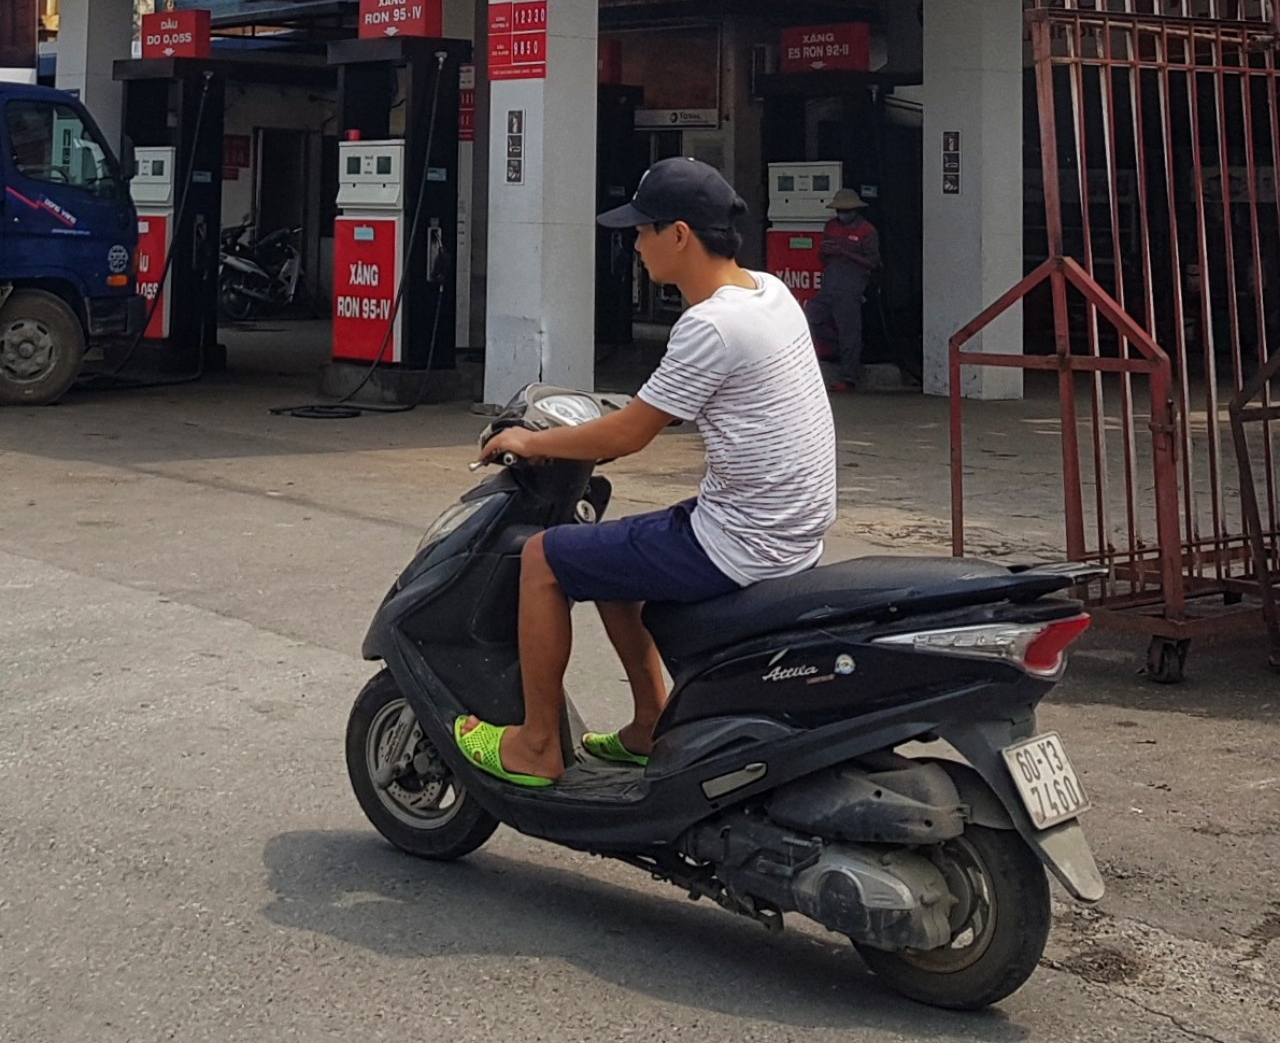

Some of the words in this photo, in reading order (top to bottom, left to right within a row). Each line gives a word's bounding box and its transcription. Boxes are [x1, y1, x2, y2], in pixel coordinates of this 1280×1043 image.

[365, 11, 390, 24] RON
[147, 34, 161, 45] DO
[802, 45, 824, 58] RON
[349, 260, 379, 287] XĂNG
[337, 296, 359, 318] RON
[362, 298, 391, 320] 95-IV
